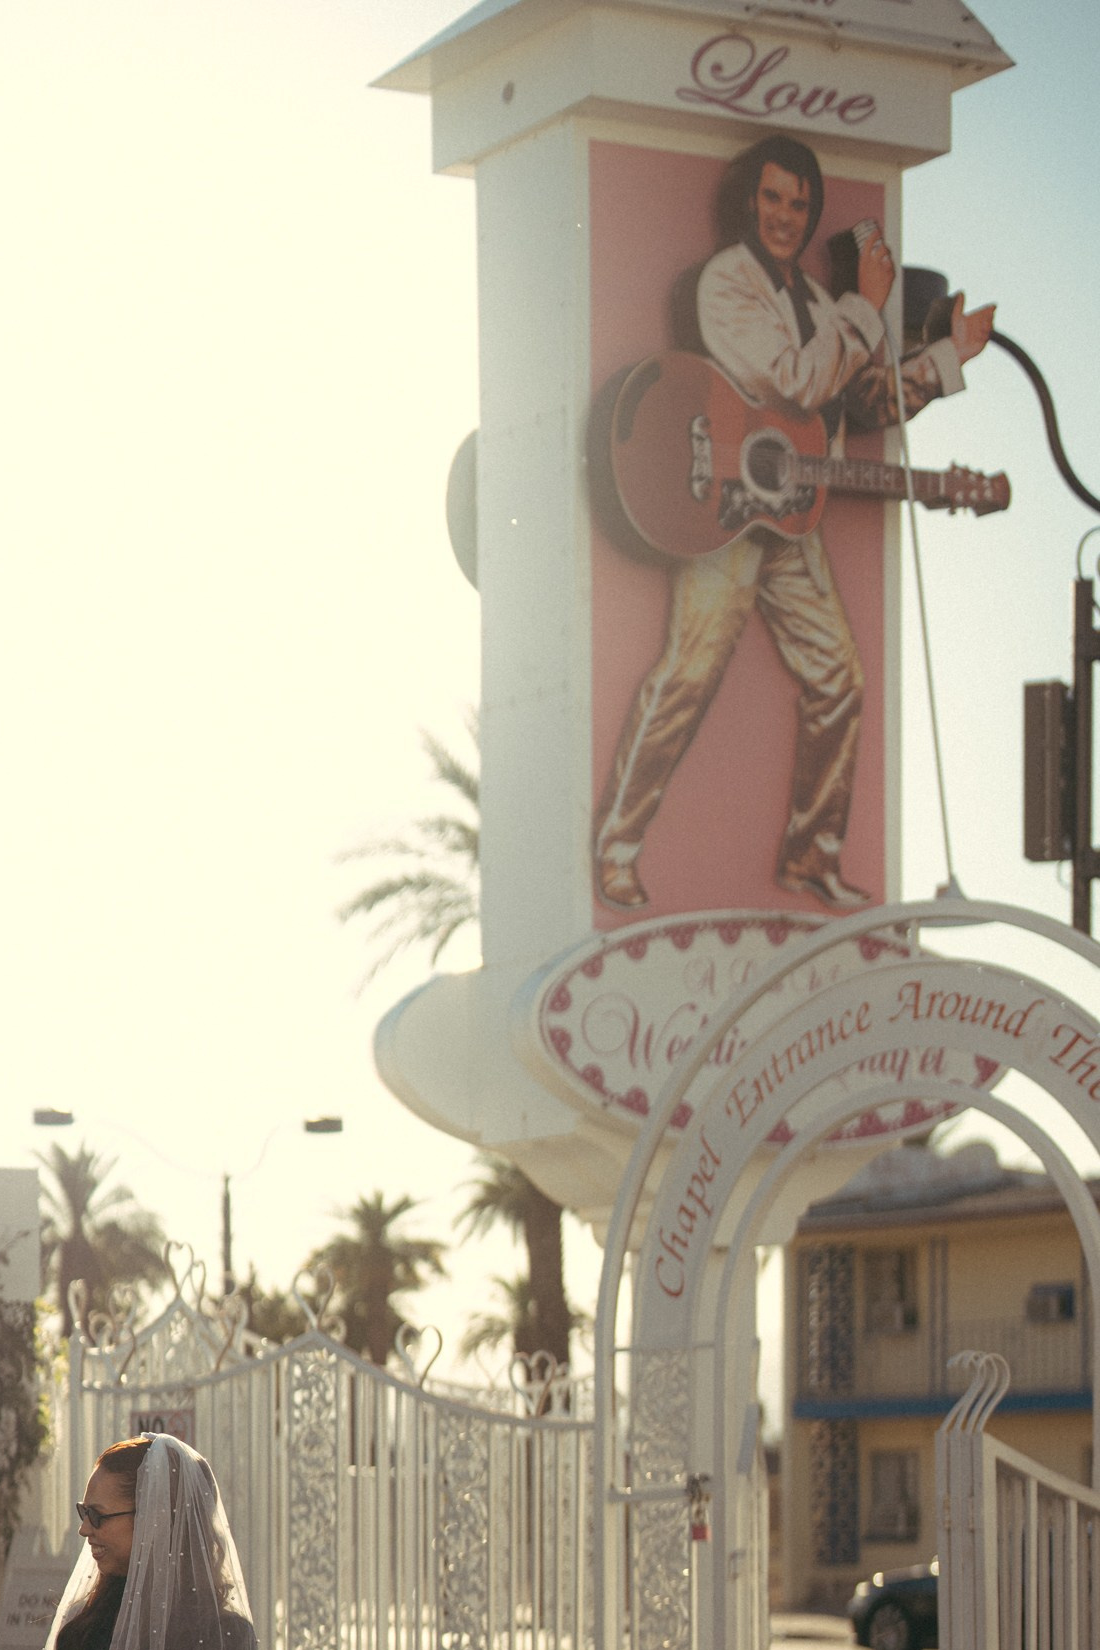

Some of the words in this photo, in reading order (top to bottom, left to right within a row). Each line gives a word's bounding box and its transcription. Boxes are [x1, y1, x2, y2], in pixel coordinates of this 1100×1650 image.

[676, 34, 876, 124] Love
[656, 1124, 722, 1298] Chapel
[725, 1001, 872, 1128] Entrance
[888, 980, 1046, 1038] Around
